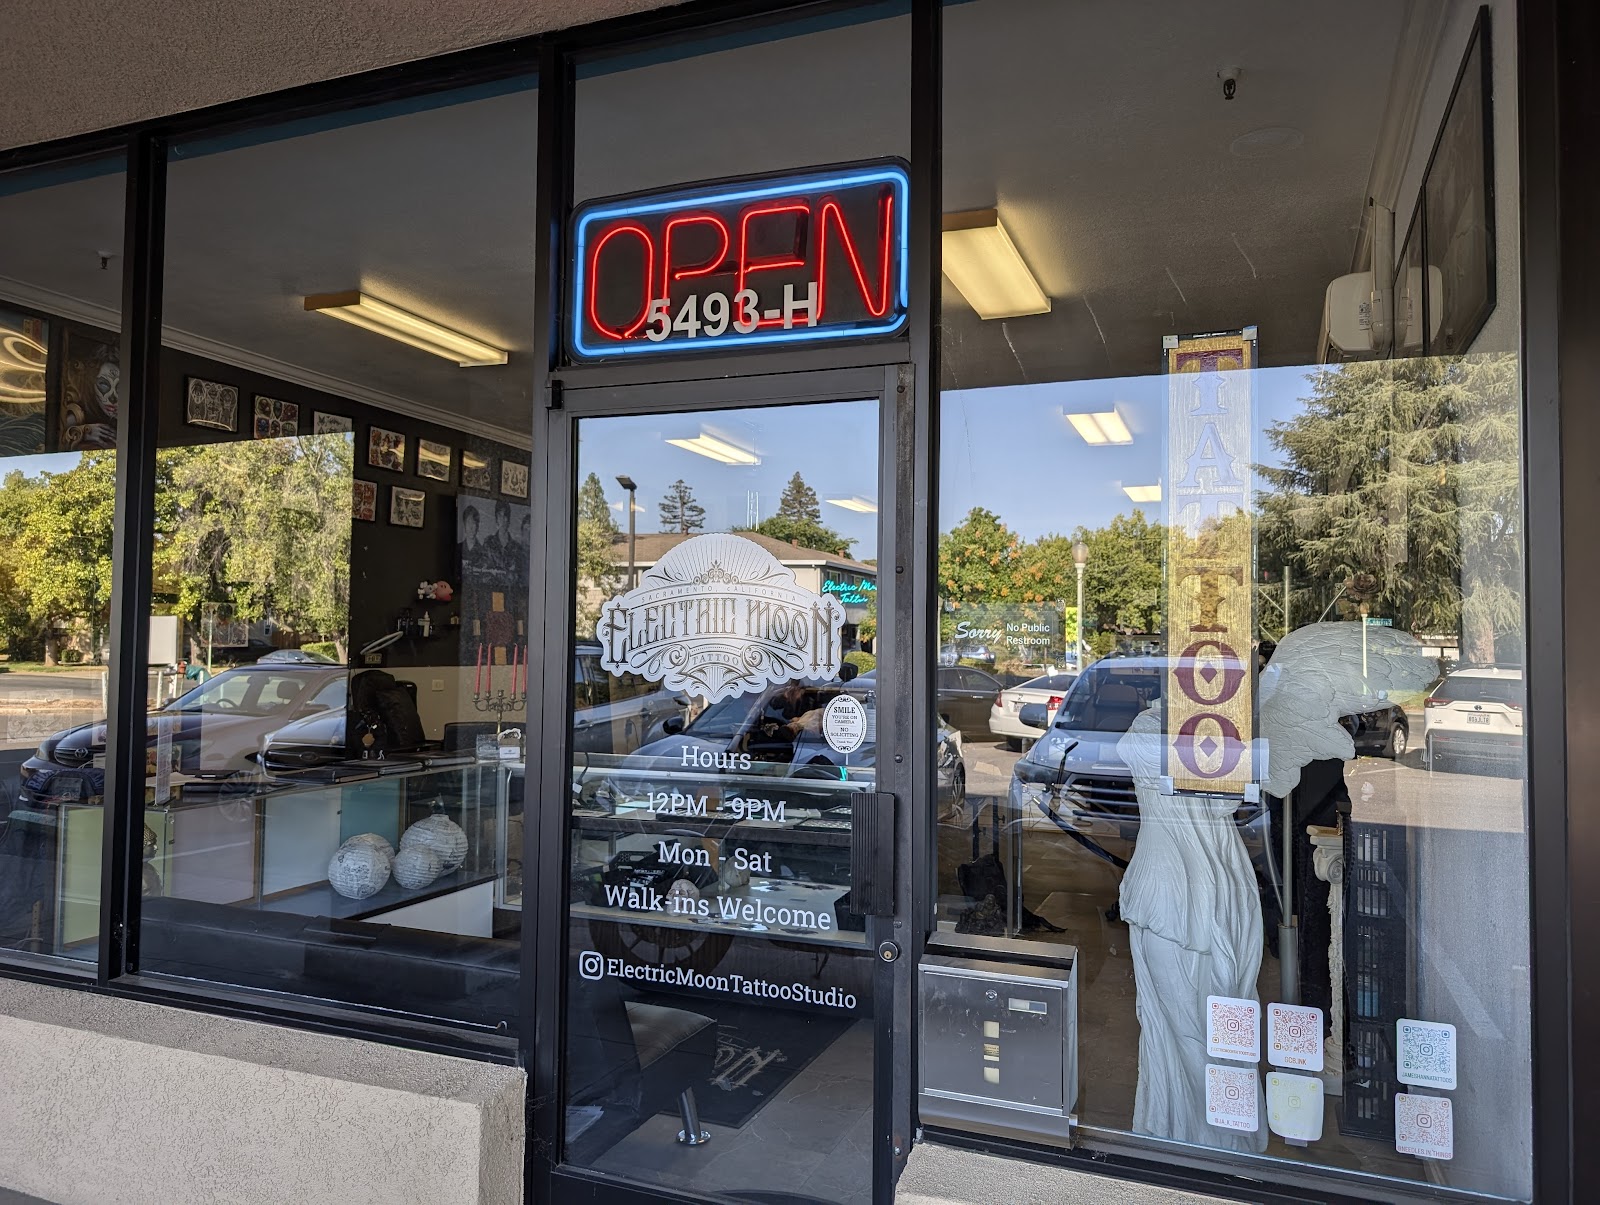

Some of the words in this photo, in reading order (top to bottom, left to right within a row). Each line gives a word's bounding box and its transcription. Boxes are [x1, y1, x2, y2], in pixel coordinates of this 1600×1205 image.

[588, 192, 893, 340] OPEN
[646, 281, 818, 342] 5493-H
[821, 579, 858, 593] Electric
[604, 598, 737, 669] ELECTRIC
[746, 598, 836, 673] MOON
[954, 621, 1003, 643] Sorry
[1006, 623, 1019, 632] No
[1021, 623, 1050, 632] Public
[1006, 636, 1050, 645] Restroom
[691, 652, 740, 666] TATTOO
[833, 706, 856, 714] SMILE
[680, 745, 752, 771] Hours
[646, 791, 709, 817] 12PM
[731, 797, 787, 823] 9PM
[657, 840, 711, 867] Mon
[733, 847, 772, 873] Sat
[603, 884, 710, 917] Walk-ins
[716, 896, 831, 930] Welcome
[606, 957, 857, 1009] ElectricMoonTattooStudio
